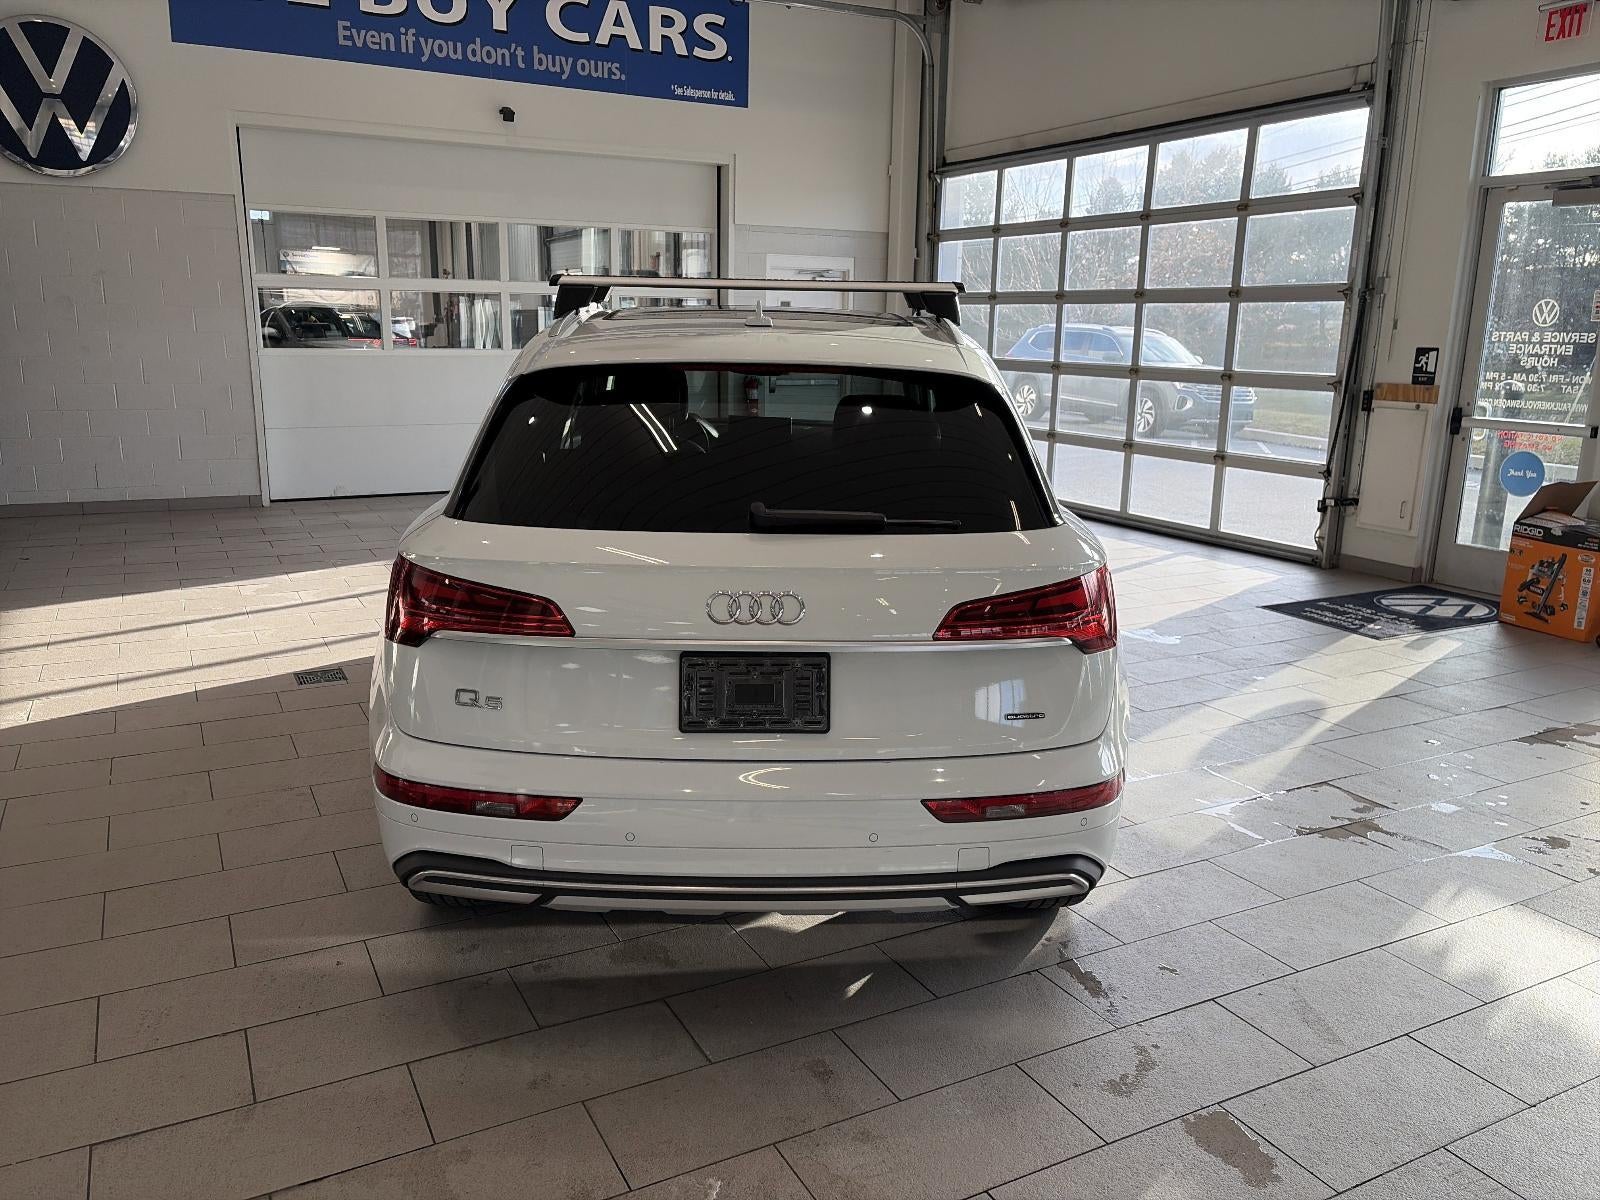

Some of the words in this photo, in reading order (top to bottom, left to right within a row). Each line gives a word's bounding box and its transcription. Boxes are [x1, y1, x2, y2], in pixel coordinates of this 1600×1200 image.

[359, 0, 519, 32] UY
[1544, 3, 1588, 42] EXIT
[337, 20, 396, 52] Even
[400, 27, 416, 54] if
[419, 36, 463, 62] you
[467, 38, 525, 69] don't
[533, 46, 572, 79] buy
[576, 57, 626, 81] ours.
[674, 84, 684, 96] See
[684, 85, 711, 99] Salesperson
[711, 88, 719, 100] for
[1507, 468, 1524, 477] Thank
[1525, 470, 1537, 478] You
[1513, 524, 1544, 537] RIDGID
[455, 688, 503, 711] Q5
